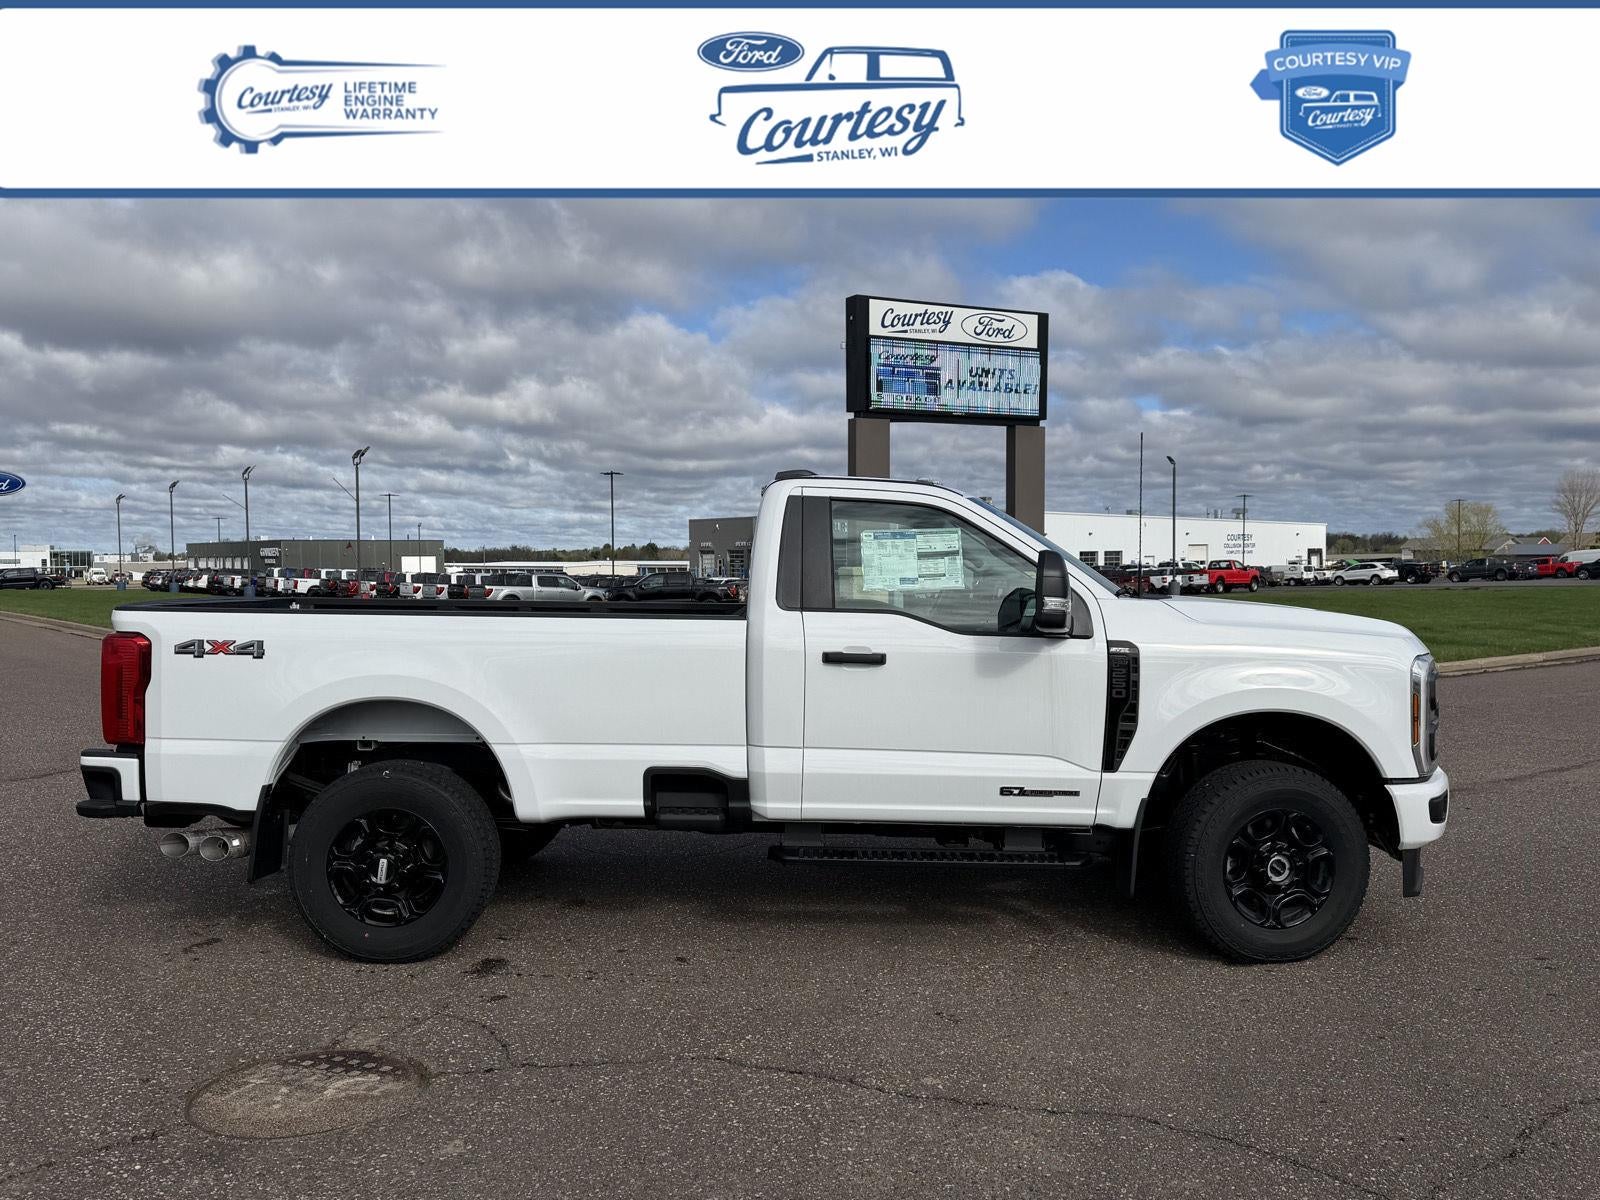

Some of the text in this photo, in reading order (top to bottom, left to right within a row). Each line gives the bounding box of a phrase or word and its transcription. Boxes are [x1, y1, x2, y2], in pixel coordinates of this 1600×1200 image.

[881, 307, 954, 333] Courtesy
[973, 315, 1016, 339] Ford
[969, 366, 1016, 380] UNITS
[1226, 533, 1253, 541] COURTESY
